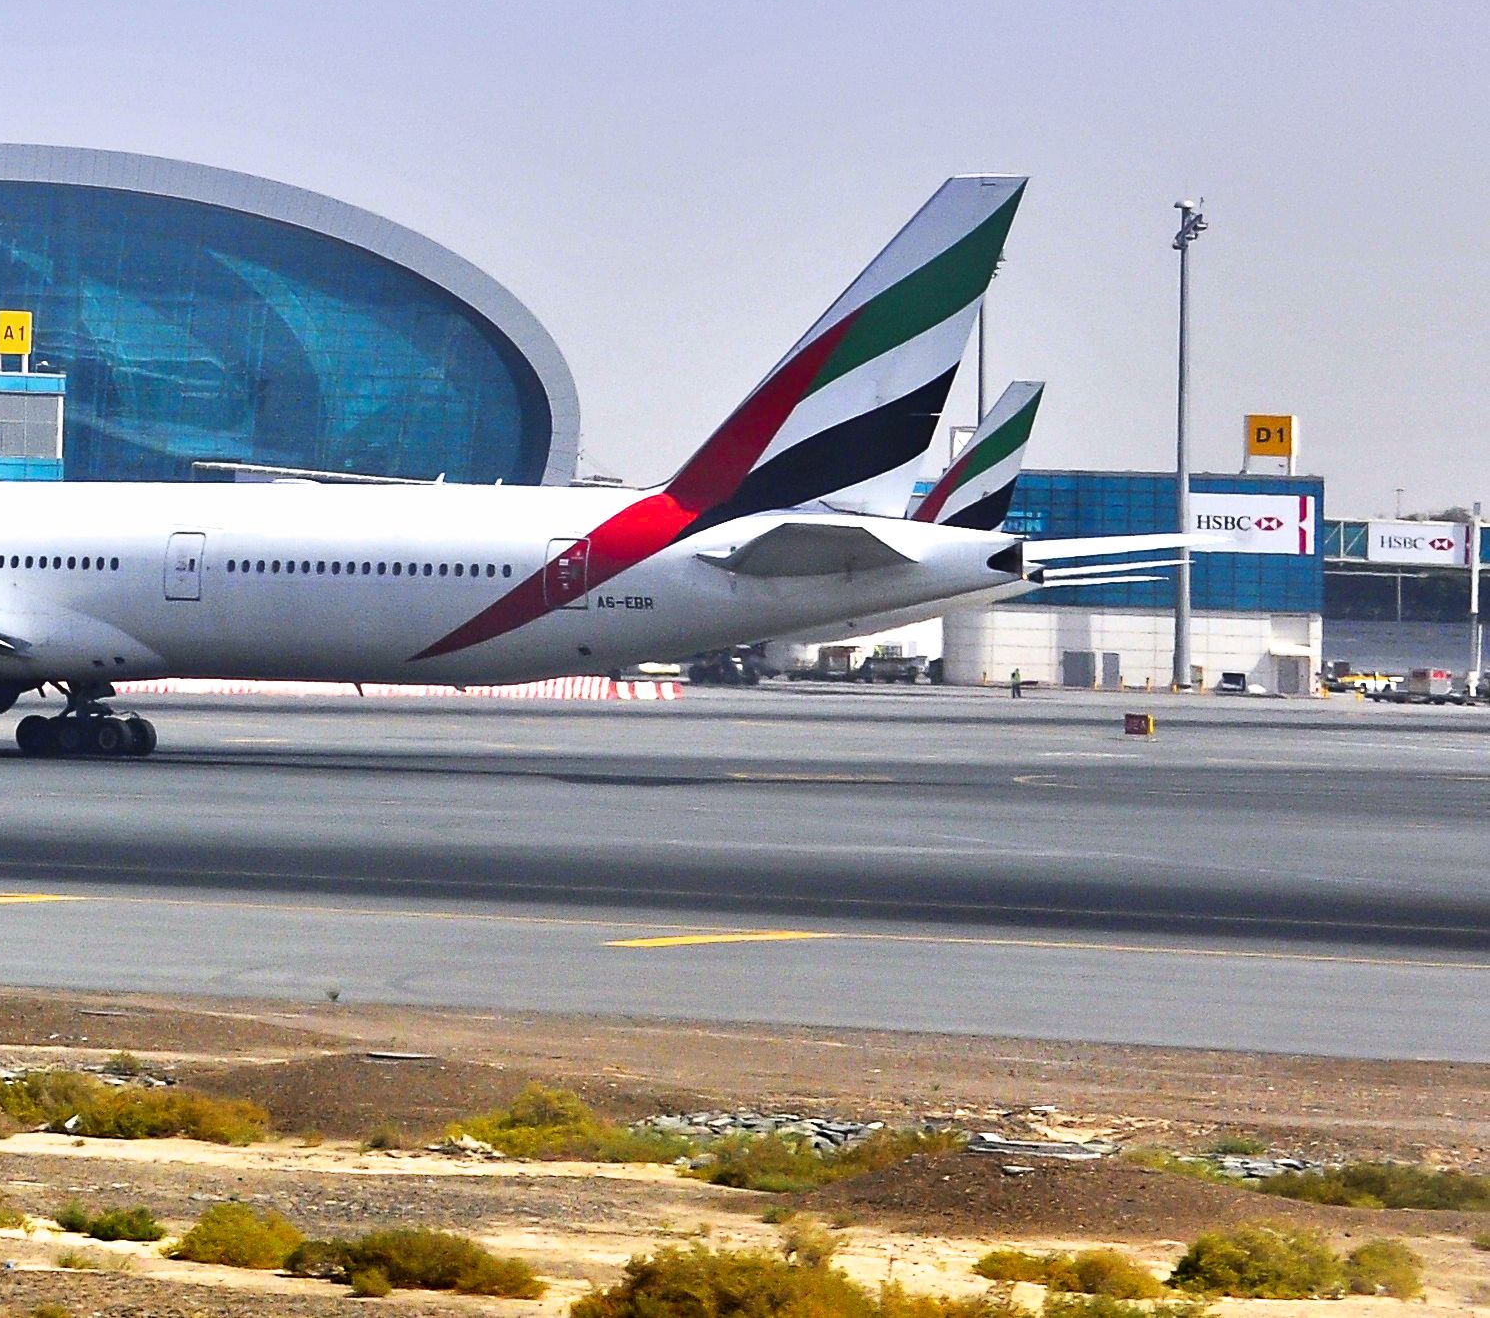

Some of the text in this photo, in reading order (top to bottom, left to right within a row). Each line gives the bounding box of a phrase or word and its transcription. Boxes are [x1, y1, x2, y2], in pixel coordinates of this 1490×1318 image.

[1196, 515, 1252, 532] HSBC
[1379, 535, 1425, 551] HSBC
[597, 596, 654, 610] A6-EBR
